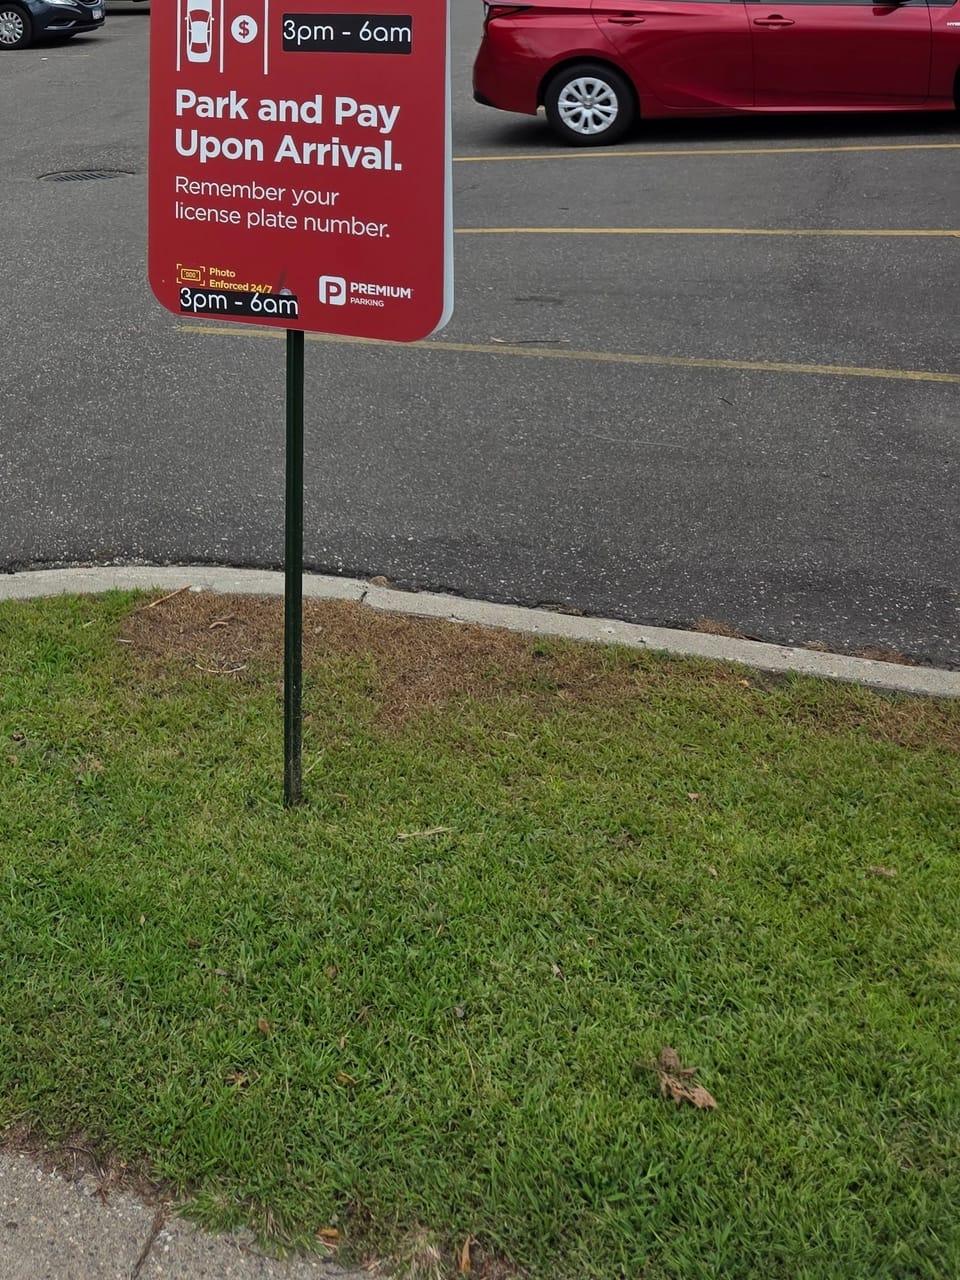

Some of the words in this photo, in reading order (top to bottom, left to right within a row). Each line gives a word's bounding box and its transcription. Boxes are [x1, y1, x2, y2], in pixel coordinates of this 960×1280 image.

[283, 20, 334, 45] 3pm
[358, 20, 412, 42] 6am
[176, 89, 248, 120] Park
[258, 94, 322, 124] and
[335, 96, 400, 134] Pay
[176, 128, 264, 163] Upon
[274, 134, 402, 171] Arrival.
[176, 176, 286, 201] Remember
[292, 188, 340, 206] your
[176, 202, 240, 224] license
[247, 208, 298, 230] plate
[304, 216, 390, 238] number.
[209, 268, 236, 278] Photo
[209, 280, 249, 292] Enforced
[250, 284, 272, 294] 24/7
[350, 282, 412, 299] PREMIUM
[180, 288, 228, 312] 3pm
[250, 292, 298, 316] 6am
[350, 297, 384, 308] PARKING
